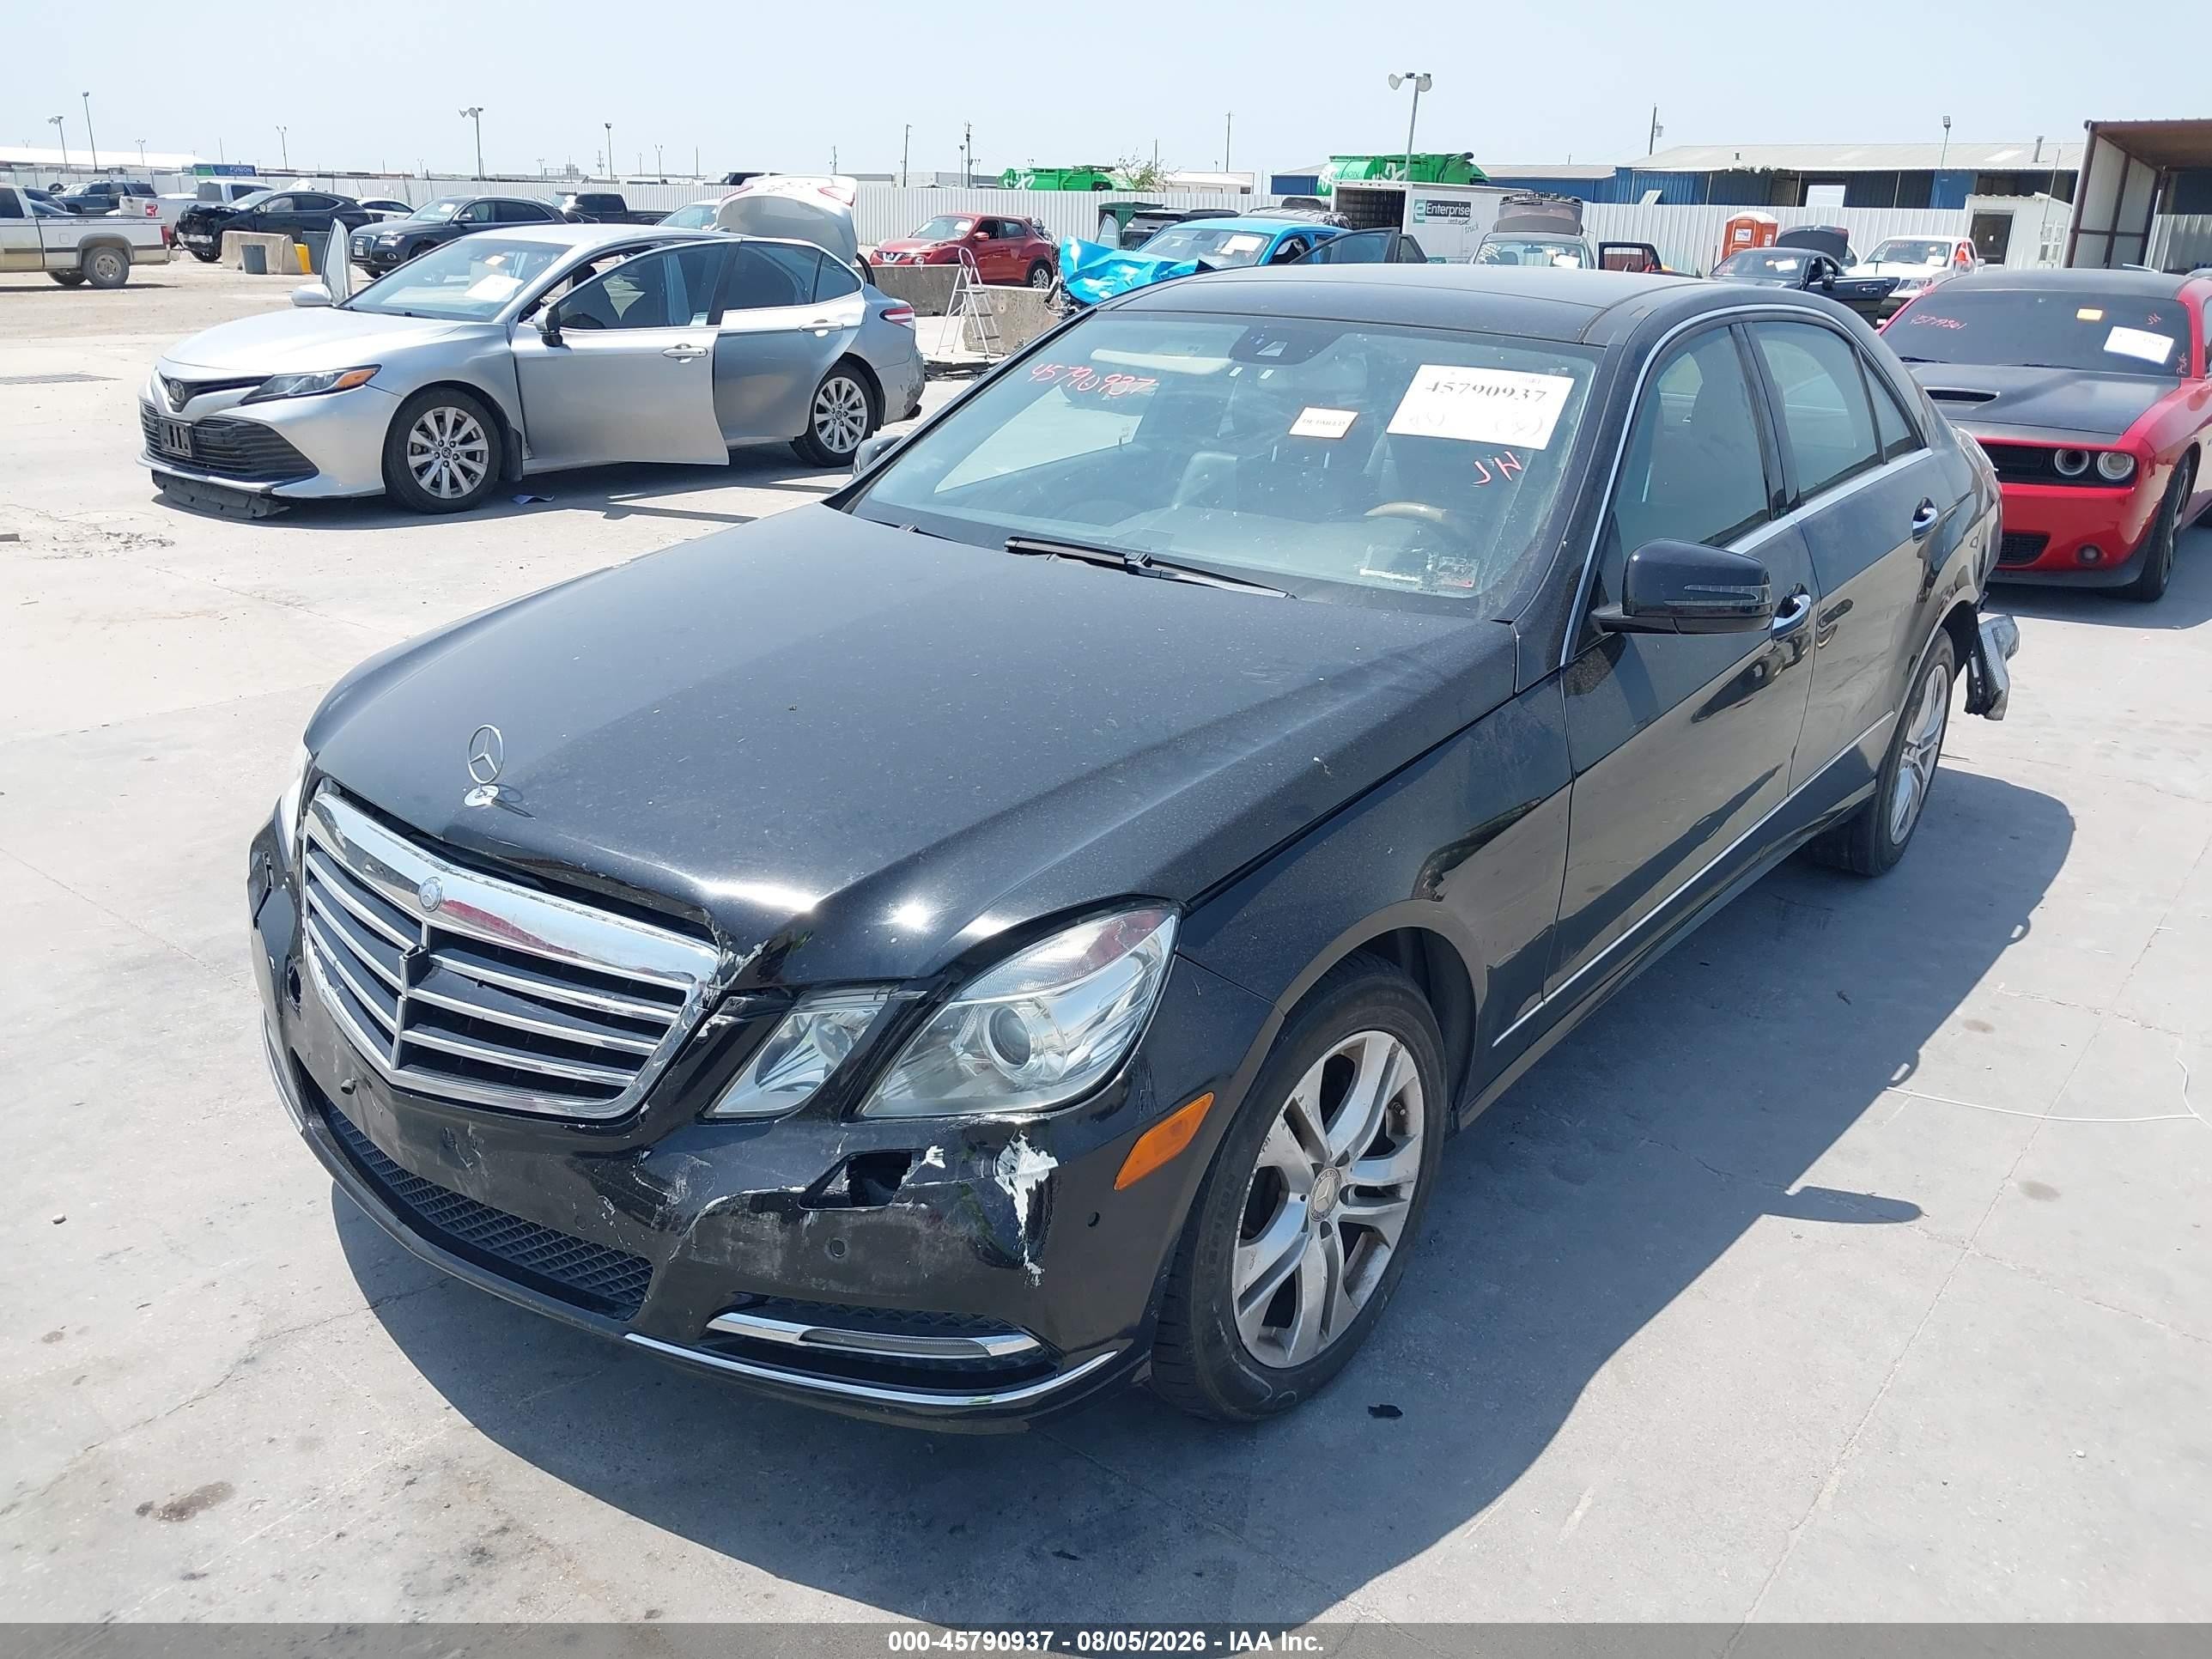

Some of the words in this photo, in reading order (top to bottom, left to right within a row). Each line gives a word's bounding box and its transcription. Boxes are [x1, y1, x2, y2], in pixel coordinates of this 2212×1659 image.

[1426, 202, 1471, 218] Enterprise
[1027, 362, 1157, 396] 45790937
[1425, 380, 1547, 403] 45790937
